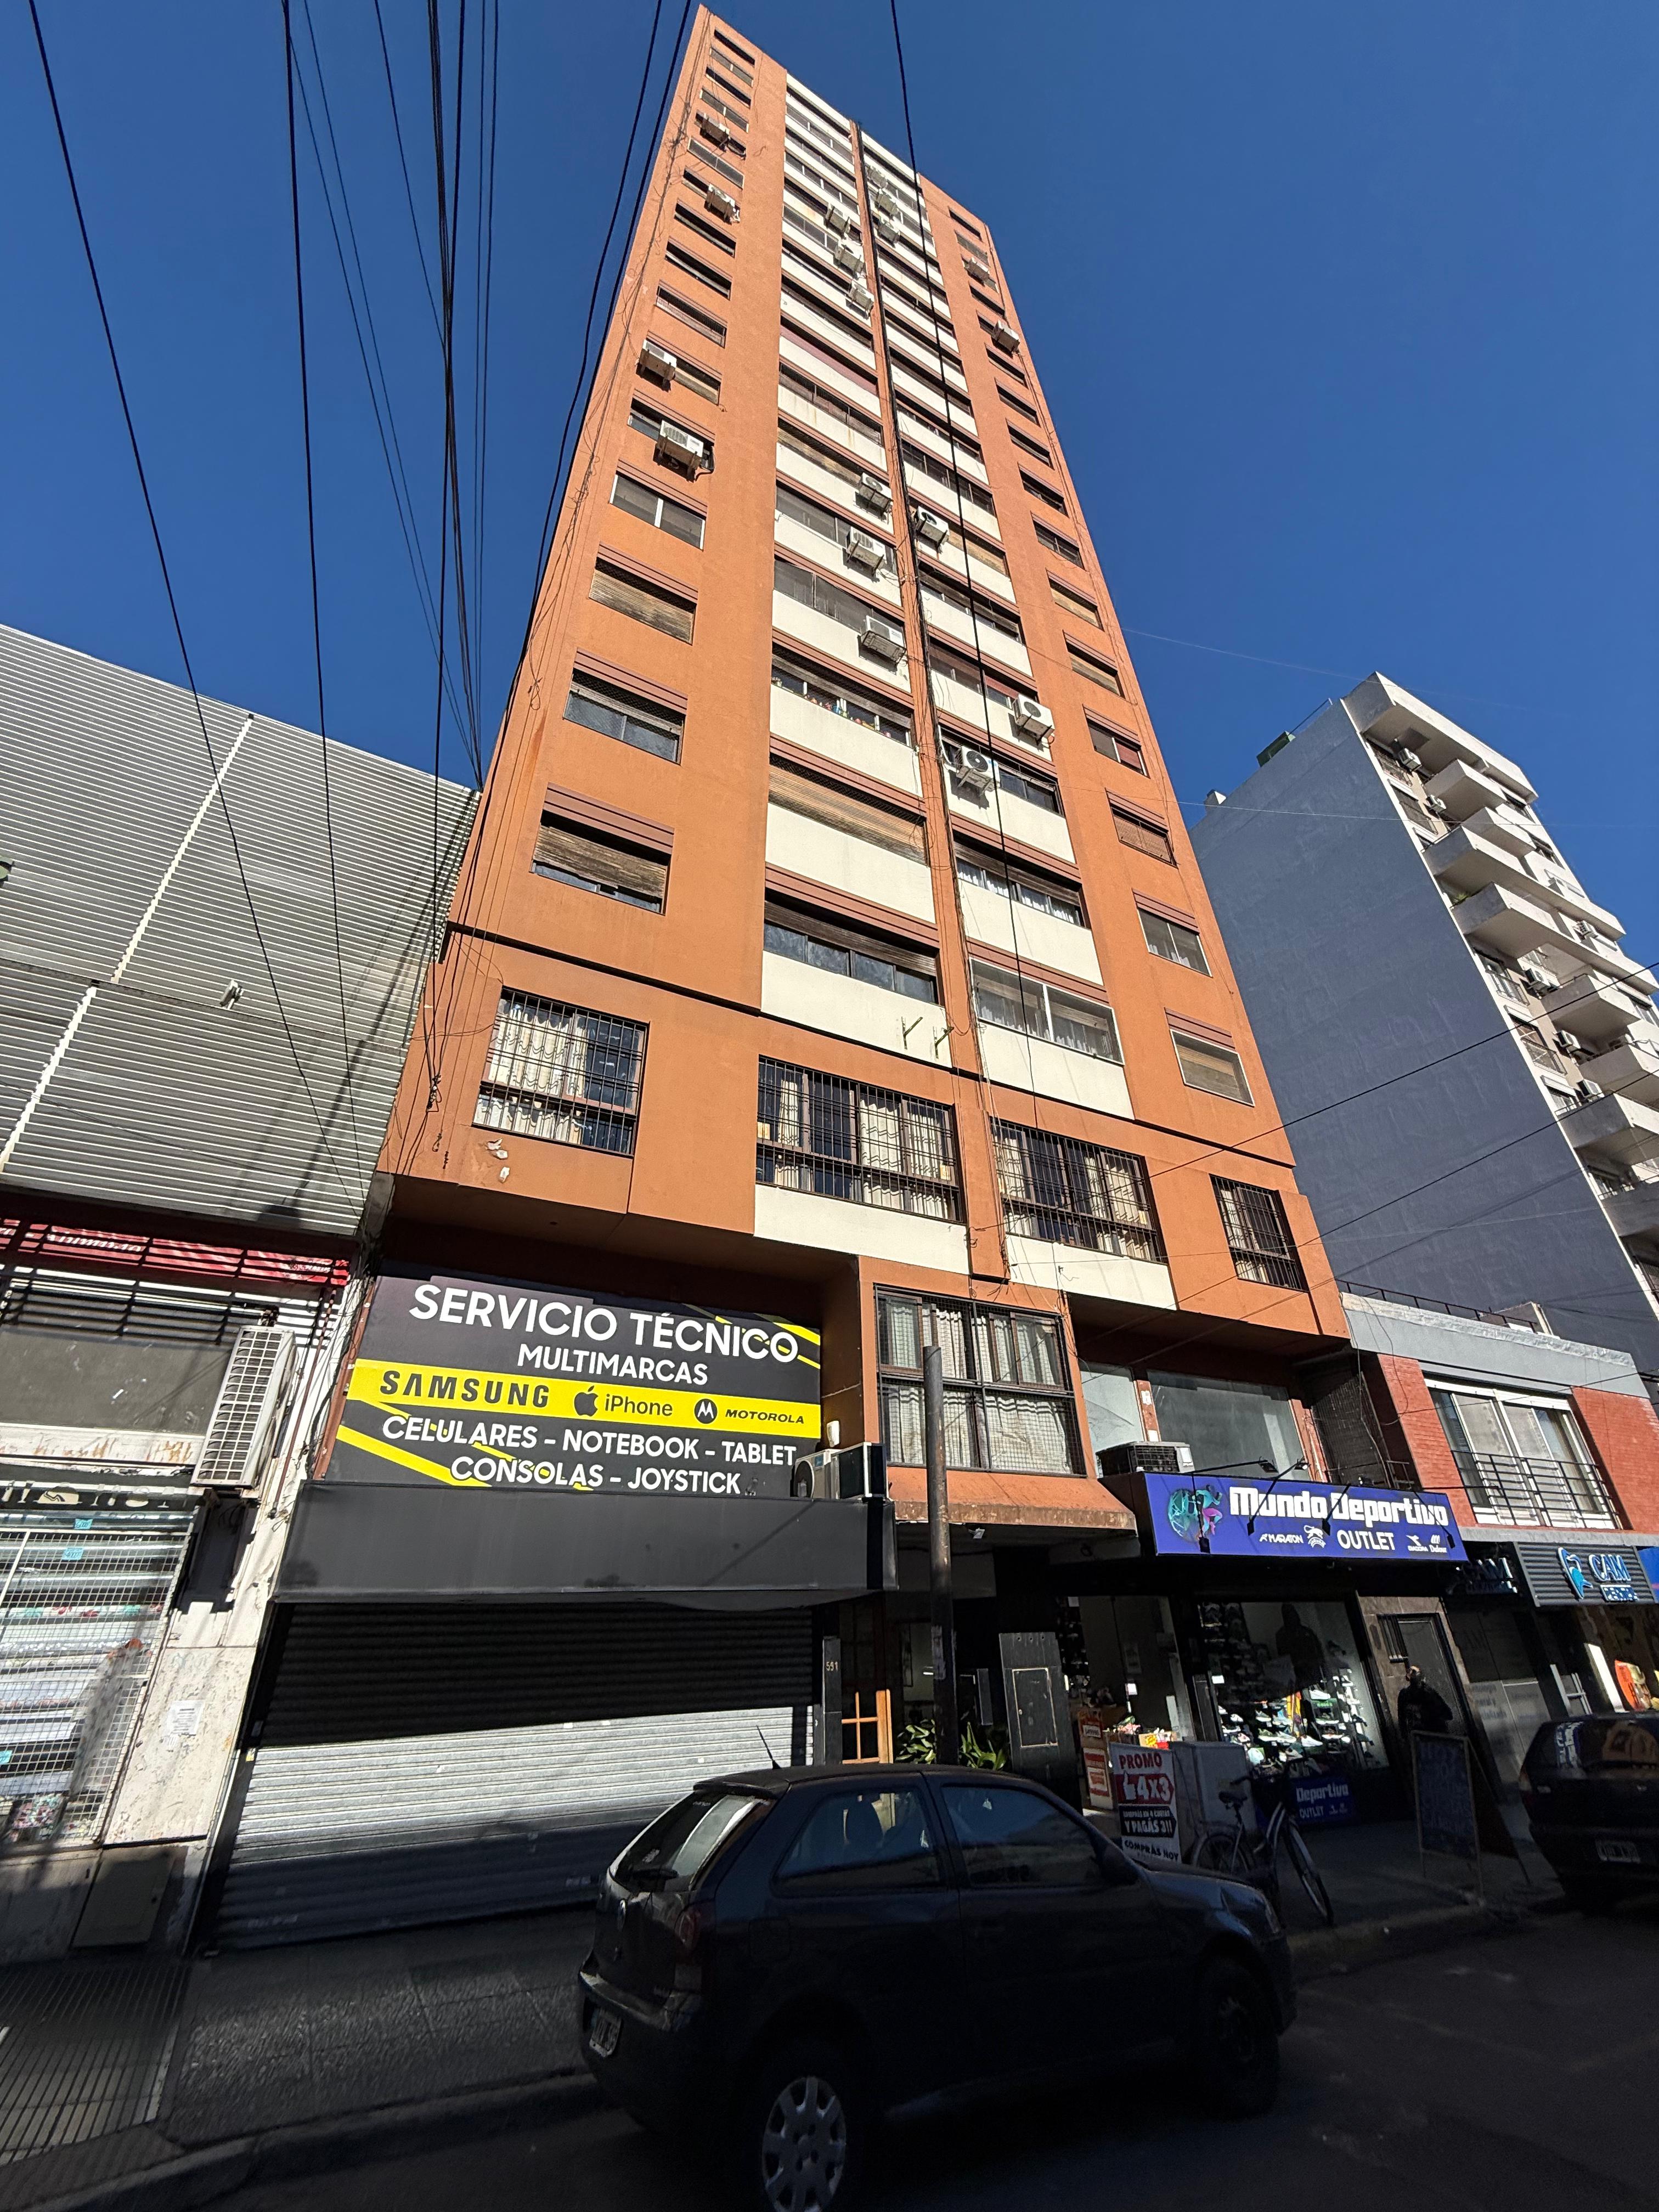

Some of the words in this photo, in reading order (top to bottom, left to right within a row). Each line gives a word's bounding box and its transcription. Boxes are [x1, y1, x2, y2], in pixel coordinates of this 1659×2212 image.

[409, 1284, 617, 1341] SERVICIO
[630, 1312, 798, 1363] TÉCNICO
[517, 1344, 709, 1386] MULTIMARCAS
[380, 1370, 550, 1408] SAMSUNG
[605, 1393, 673, 1417] iPhone
[725, 1409, 804, 1424] MOTOROLA
[382, 1414, 538, 1449] CELULARES
[562, 1431, 699, 1460] NOTEBOOK
[721, 1441, 797, 1466] TABLET
[450, 1457, 604, 1487] CONSOLAS
[627, 1467, 741, 1494] JOYSTICK
[1229, 1486, 1328, 1519] Mundo
[1330, 1492, 1448, 1528] Deportivo
[1268, 1534, 1304, 1544] MARATON
[1337, 1530, 1395, 1550] OUTLET
[1589, 1554, 1632, 1582] CAM
[826, 1661, 838, 1672] 591
[1119, 1752, 1163, 1769] PROMO
[1295, 1781, 1350, 1804] Deportivo
[1299, 1805, 1324, 1819] OUTLET
[1125, 1820, 1131, 1833] Y
[1131, 1817, 1160, 1833] PAGÁS
[1163, 1849, 1179, 1861] HOY
